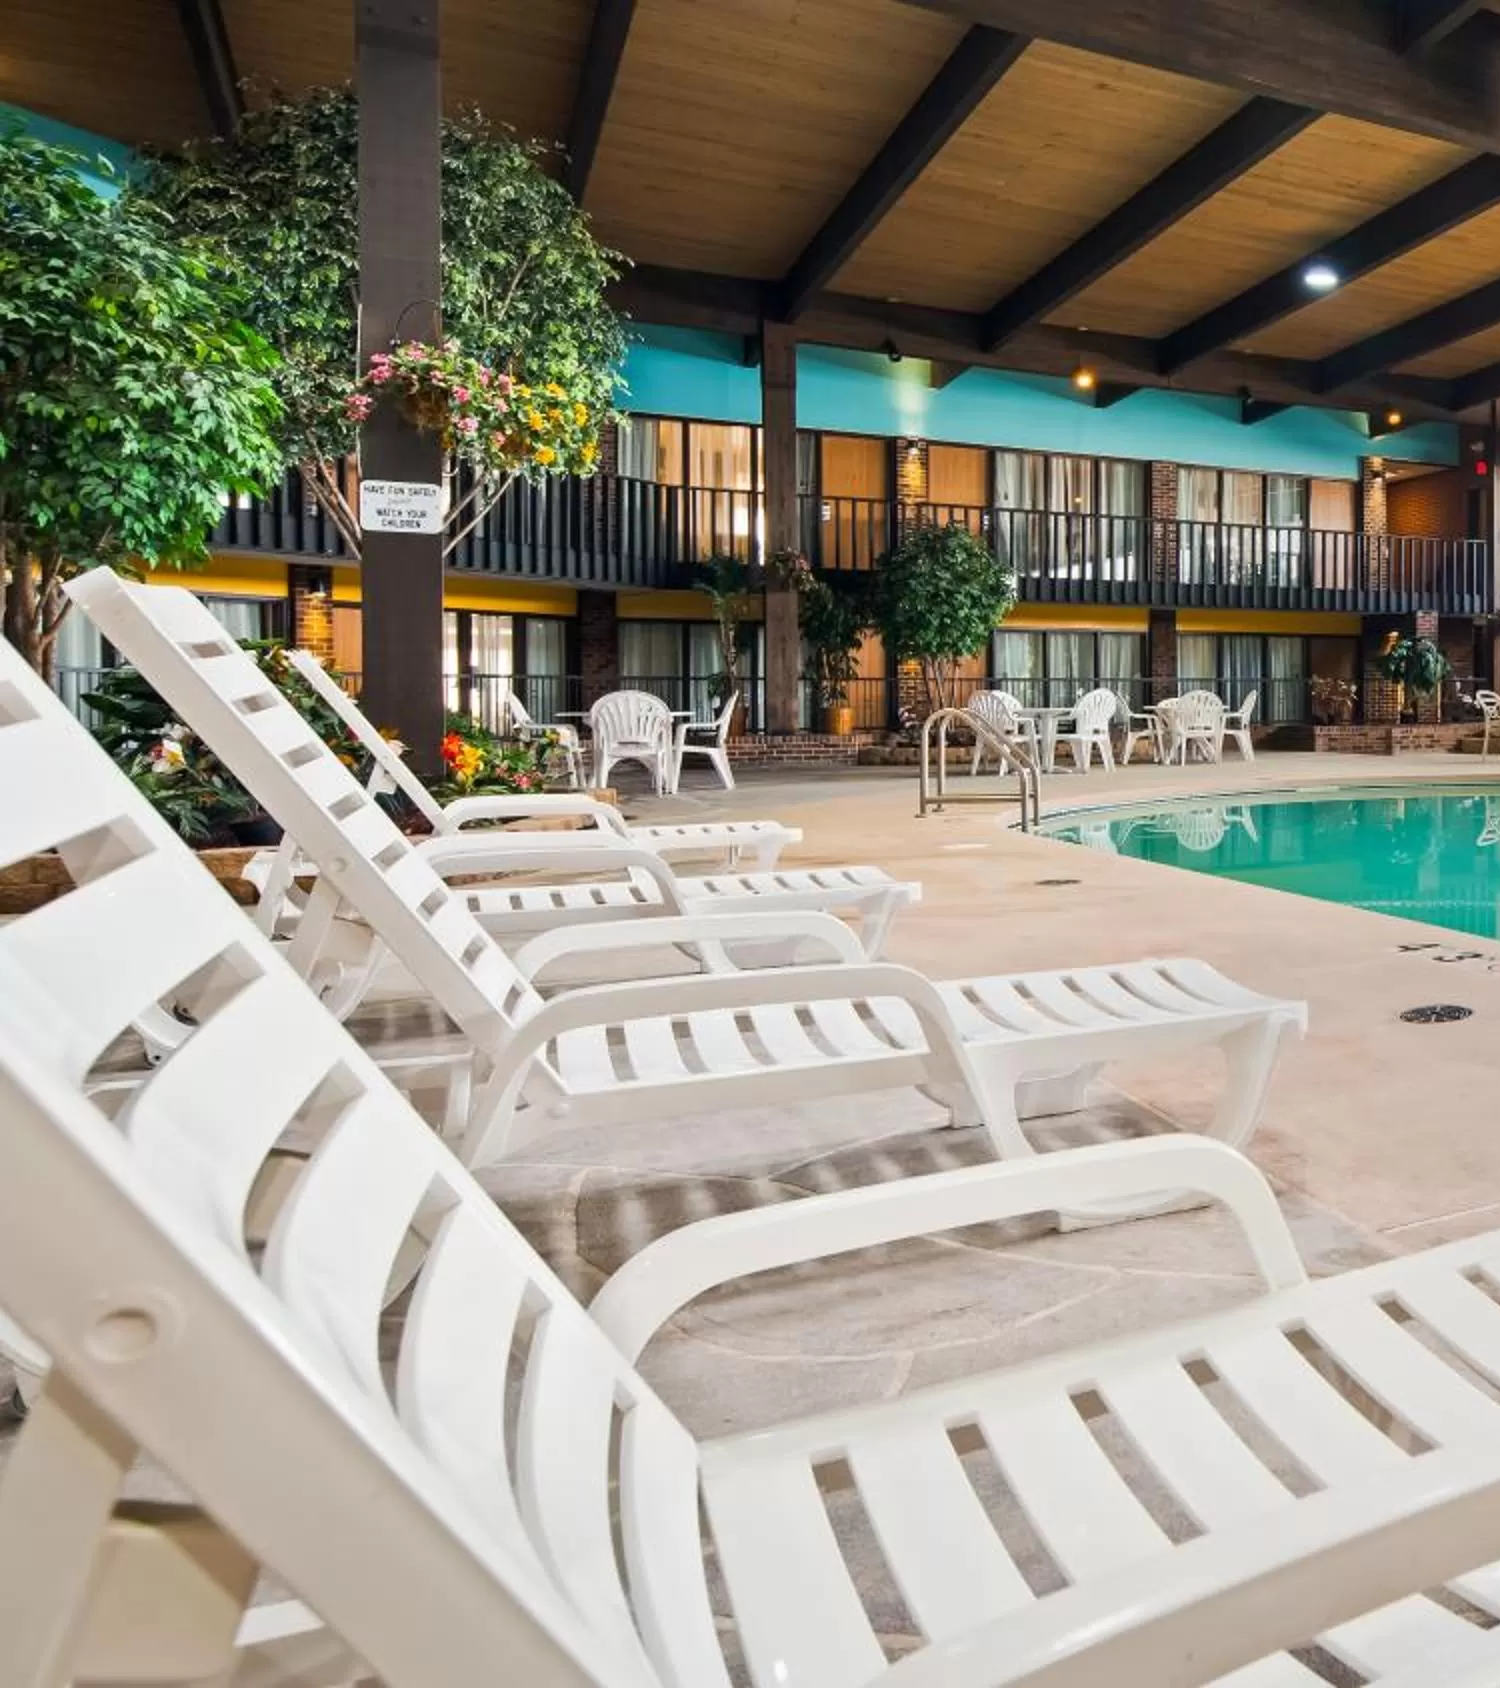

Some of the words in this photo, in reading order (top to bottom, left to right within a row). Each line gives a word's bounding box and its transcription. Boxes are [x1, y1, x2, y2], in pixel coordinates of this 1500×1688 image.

[364, 484, 385, 494] HAVE
[387, 486, 405, 495] FUN
[408, 487, 437, 496] SAFELY
[376, 508, 403, 517] WATCH
[407, 510, 427, 519] YOUR
[381, 519, 421, 528] CHILDREN
